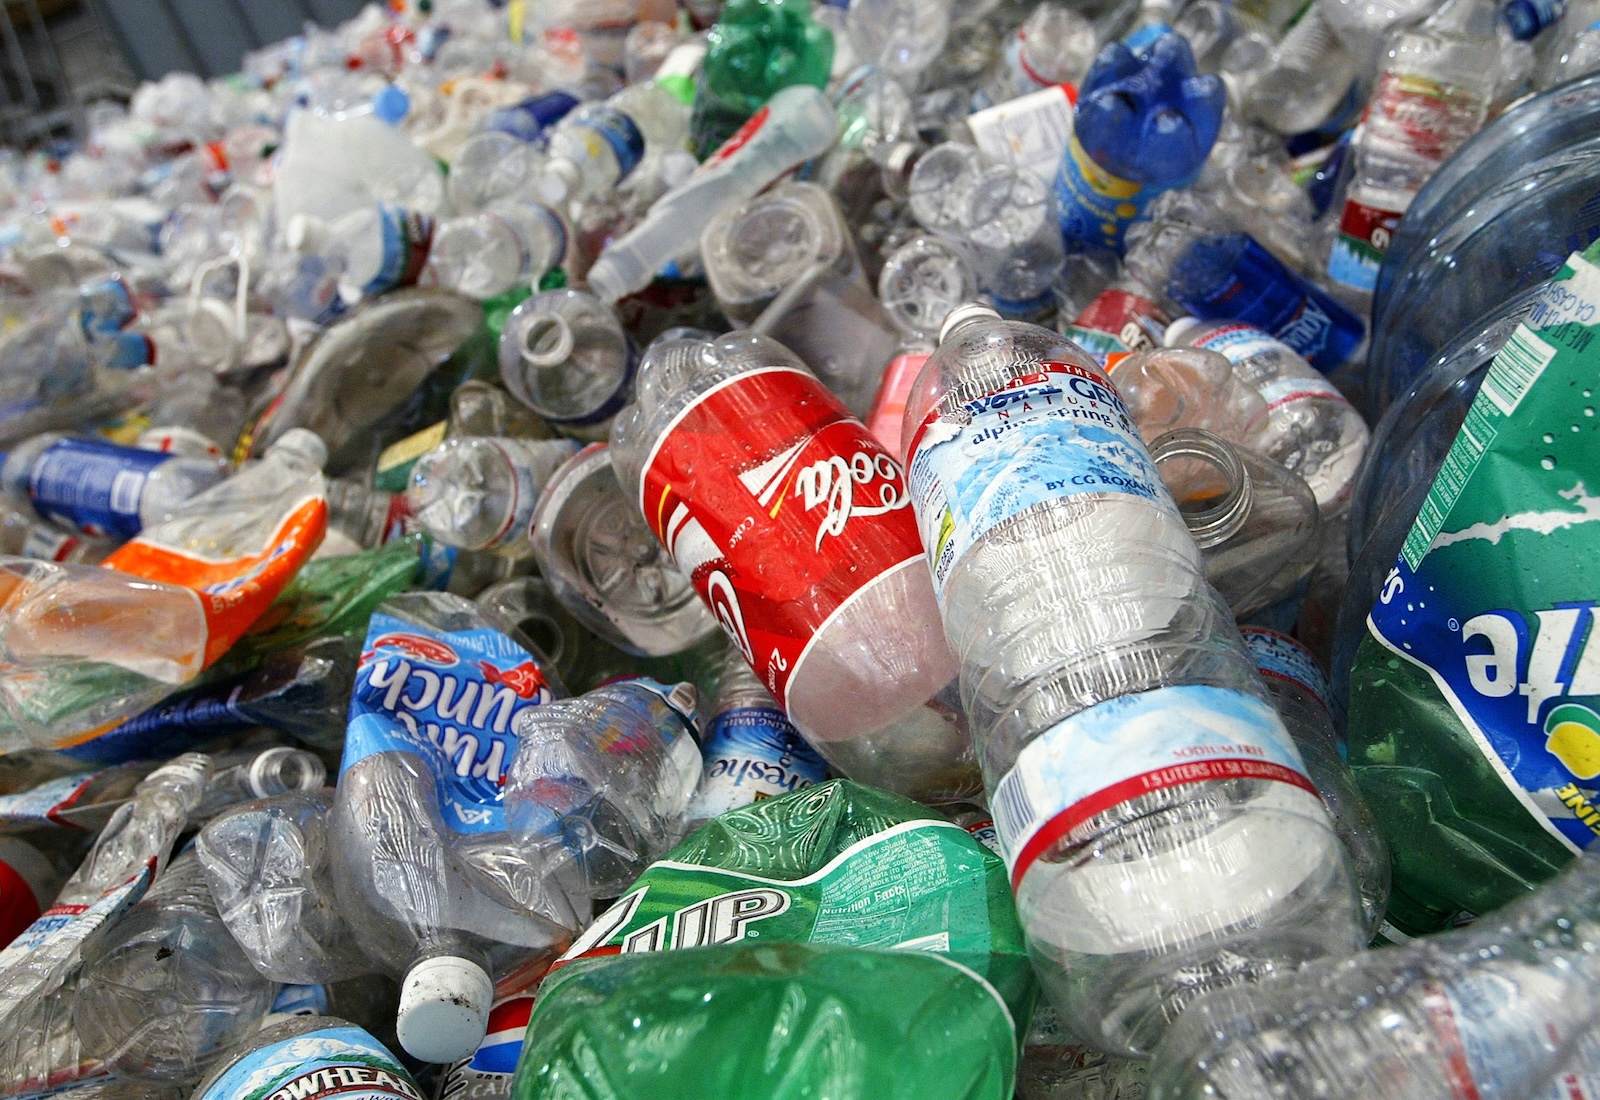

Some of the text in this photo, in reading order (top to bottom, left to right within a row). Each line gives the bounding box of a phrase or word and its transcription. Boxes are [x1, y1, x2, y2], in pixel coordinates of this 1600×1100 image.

[1064, 364, 1092, 380] THE
[972, 418, 1039, 445] alpine
[1047, 405, 1115, 428] spring
[1046, 480, 1065, 491] BY
[1071, 475, 1096, 486] CG
[730, 516, 755, 549] Coke
[771, 648, 788, 672] 2
[710, 758, 812, 792] reshe
[1162, 762, 1210, 784] LITERS
[822, 896, 871, 915] Nutrition
[873, 884, 905, 902] Facts
